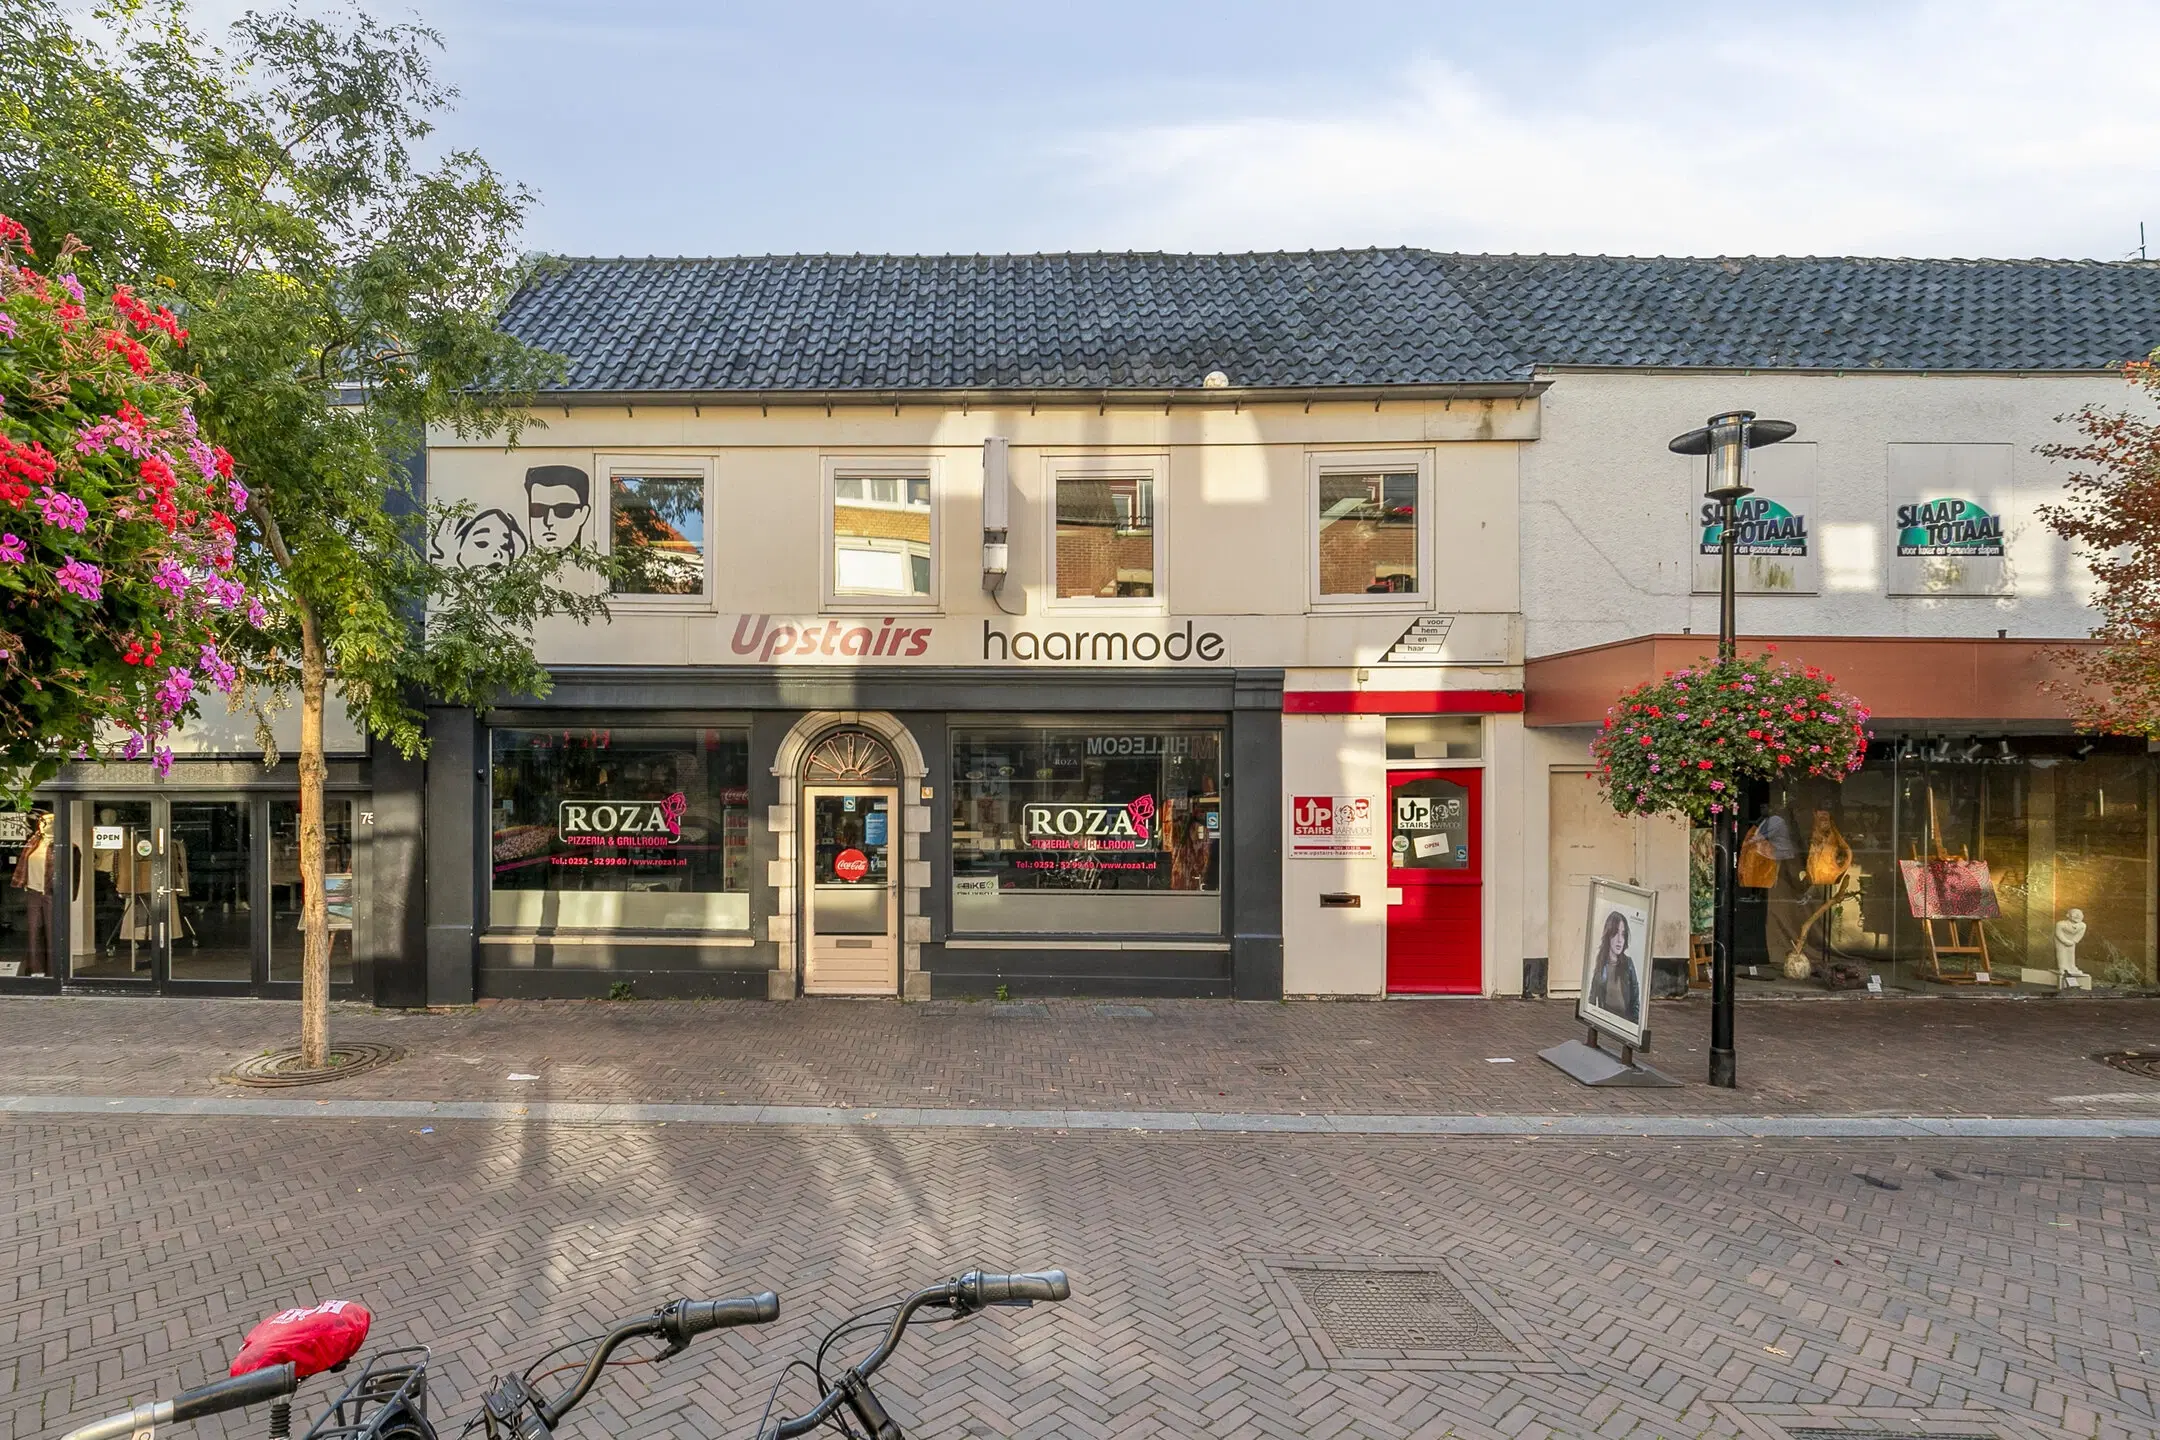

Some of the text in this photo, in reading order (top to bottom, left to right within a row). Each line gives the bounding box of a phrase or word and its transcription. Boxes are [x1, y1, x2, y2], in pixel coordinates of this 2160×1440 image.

[1896, 500, 1966, 529] SLAAP
[1926, 514, 2004, 546] TOTAAL
[731, 614, 1225, 662] Upstairs haarmode
[565, 806, 671, 832] ROZA
[1295, 802, 1332, 827] UP
[1400, 804, 1429, 821] UP
[1029, 808, 1137, 836] ROZA
[1400, 821, 1429, 829] STAIRS
[1295, 826, 1332, 835] STAIRS
[567, 836, 668, 847] PIZZERIA & GRILLROOM
[1031, 838, 1071, 849] PIZZERIA
[1073, 839, 1080, 849] &
[1423, 841, 1440, 849] OPEN
[551, 857, 568, 866] Tel.:
[568, 857, 589, 866] 0252
[594, 857, 604, 866] 52
[605, 857, 616, 866] 99
[616, 857, 627, 866] 60
[632, 857, 688, 866] www.roza1.nl
[1015, 860, 1033, 869] Tel.:
[1034, 861, 1055, 870] 0252
[1060, 861, 1071, 870] 52
[1099, 860, 1157, 870] www.roza1.nl
